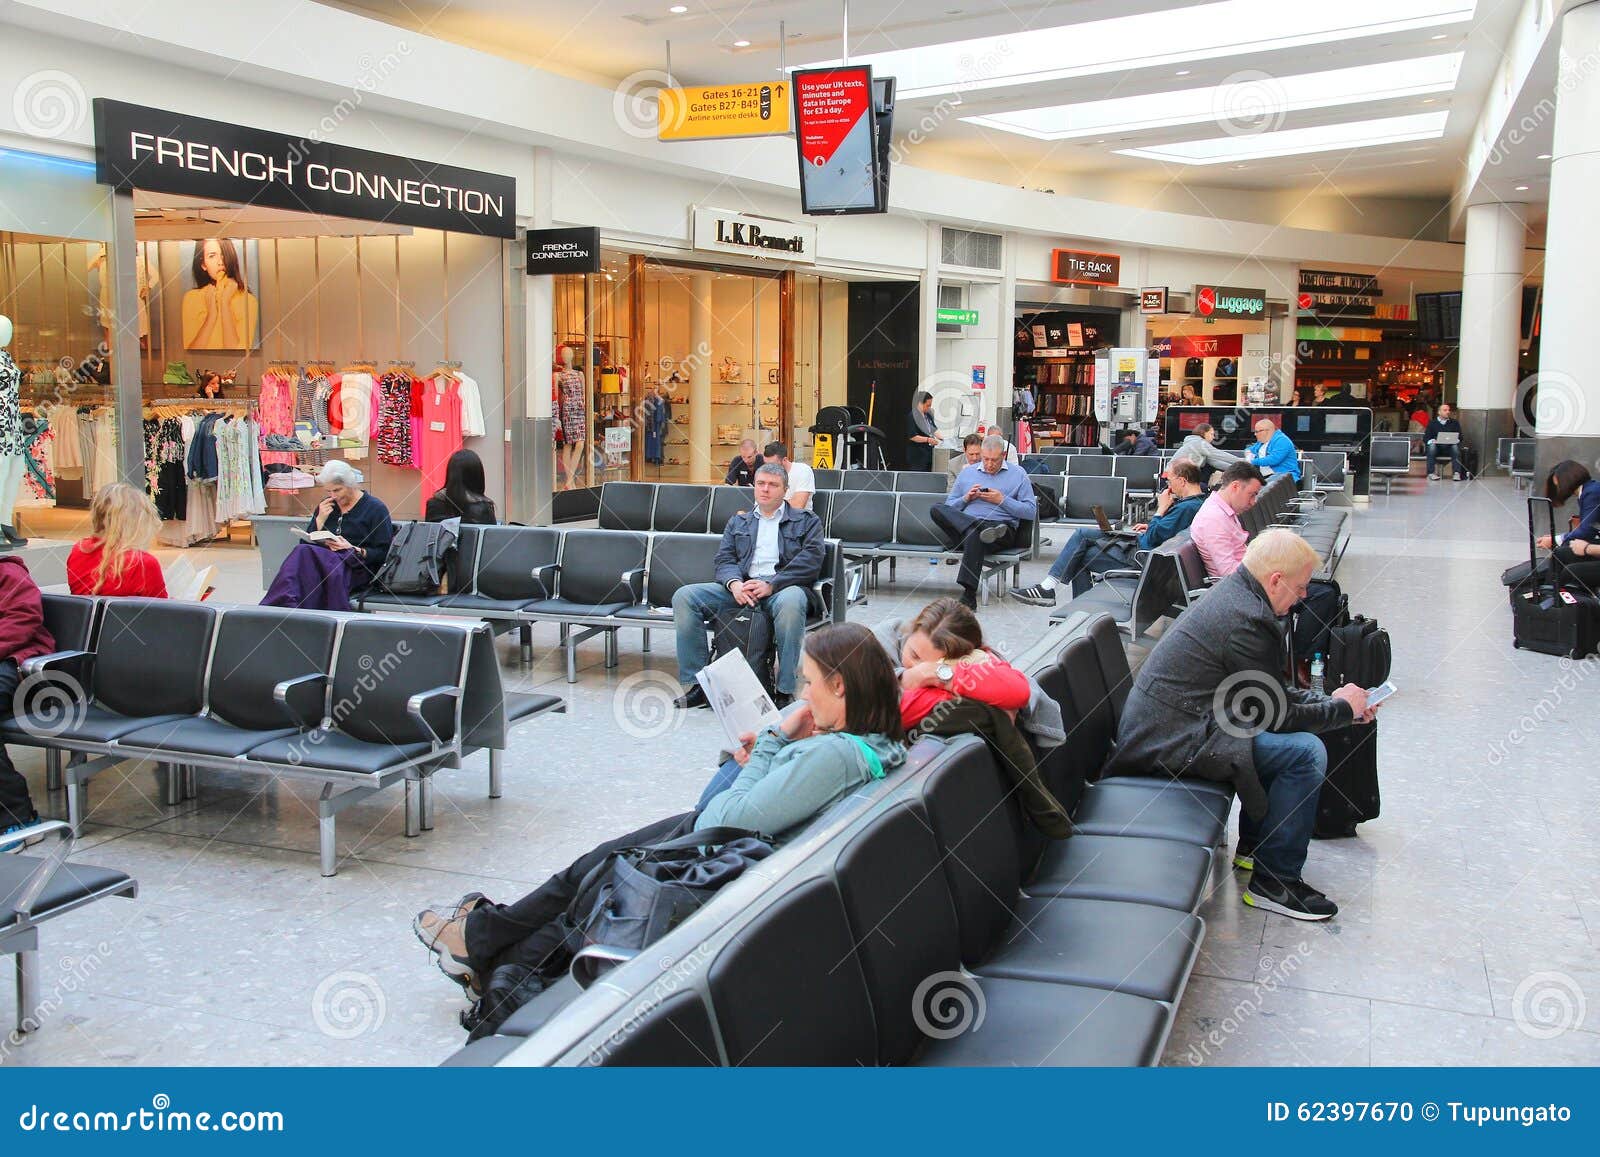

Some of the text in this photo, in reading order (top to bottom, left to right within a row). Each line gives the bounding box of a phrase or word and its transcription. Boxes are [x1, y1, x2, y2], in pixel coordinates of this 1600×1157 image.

[802, 83, 815, 91] Use
[815, 83, 832, 91] your
[702, 90, 729, 100] Gates
[802, 91, 831, 99] minutes
[827, 98, 852, 106] Europe
[690, 103, 717, 112] Gates
[688, 114, 710, 122] Airline
[738, 111, 758, 119] desks
[130, 131, 503, 217] FRENCH CONNECTION
[542, 243, 578, 251] FRENCH
[532, 250, 589, 259] CONNECTION
[1069, 258, 1112, 273] TIE RACK
[1215, 292, 1264, 314] Luggage
[1050, 329, 1061, 337] 50%
[1085, 328, 1097, 336] 50%
